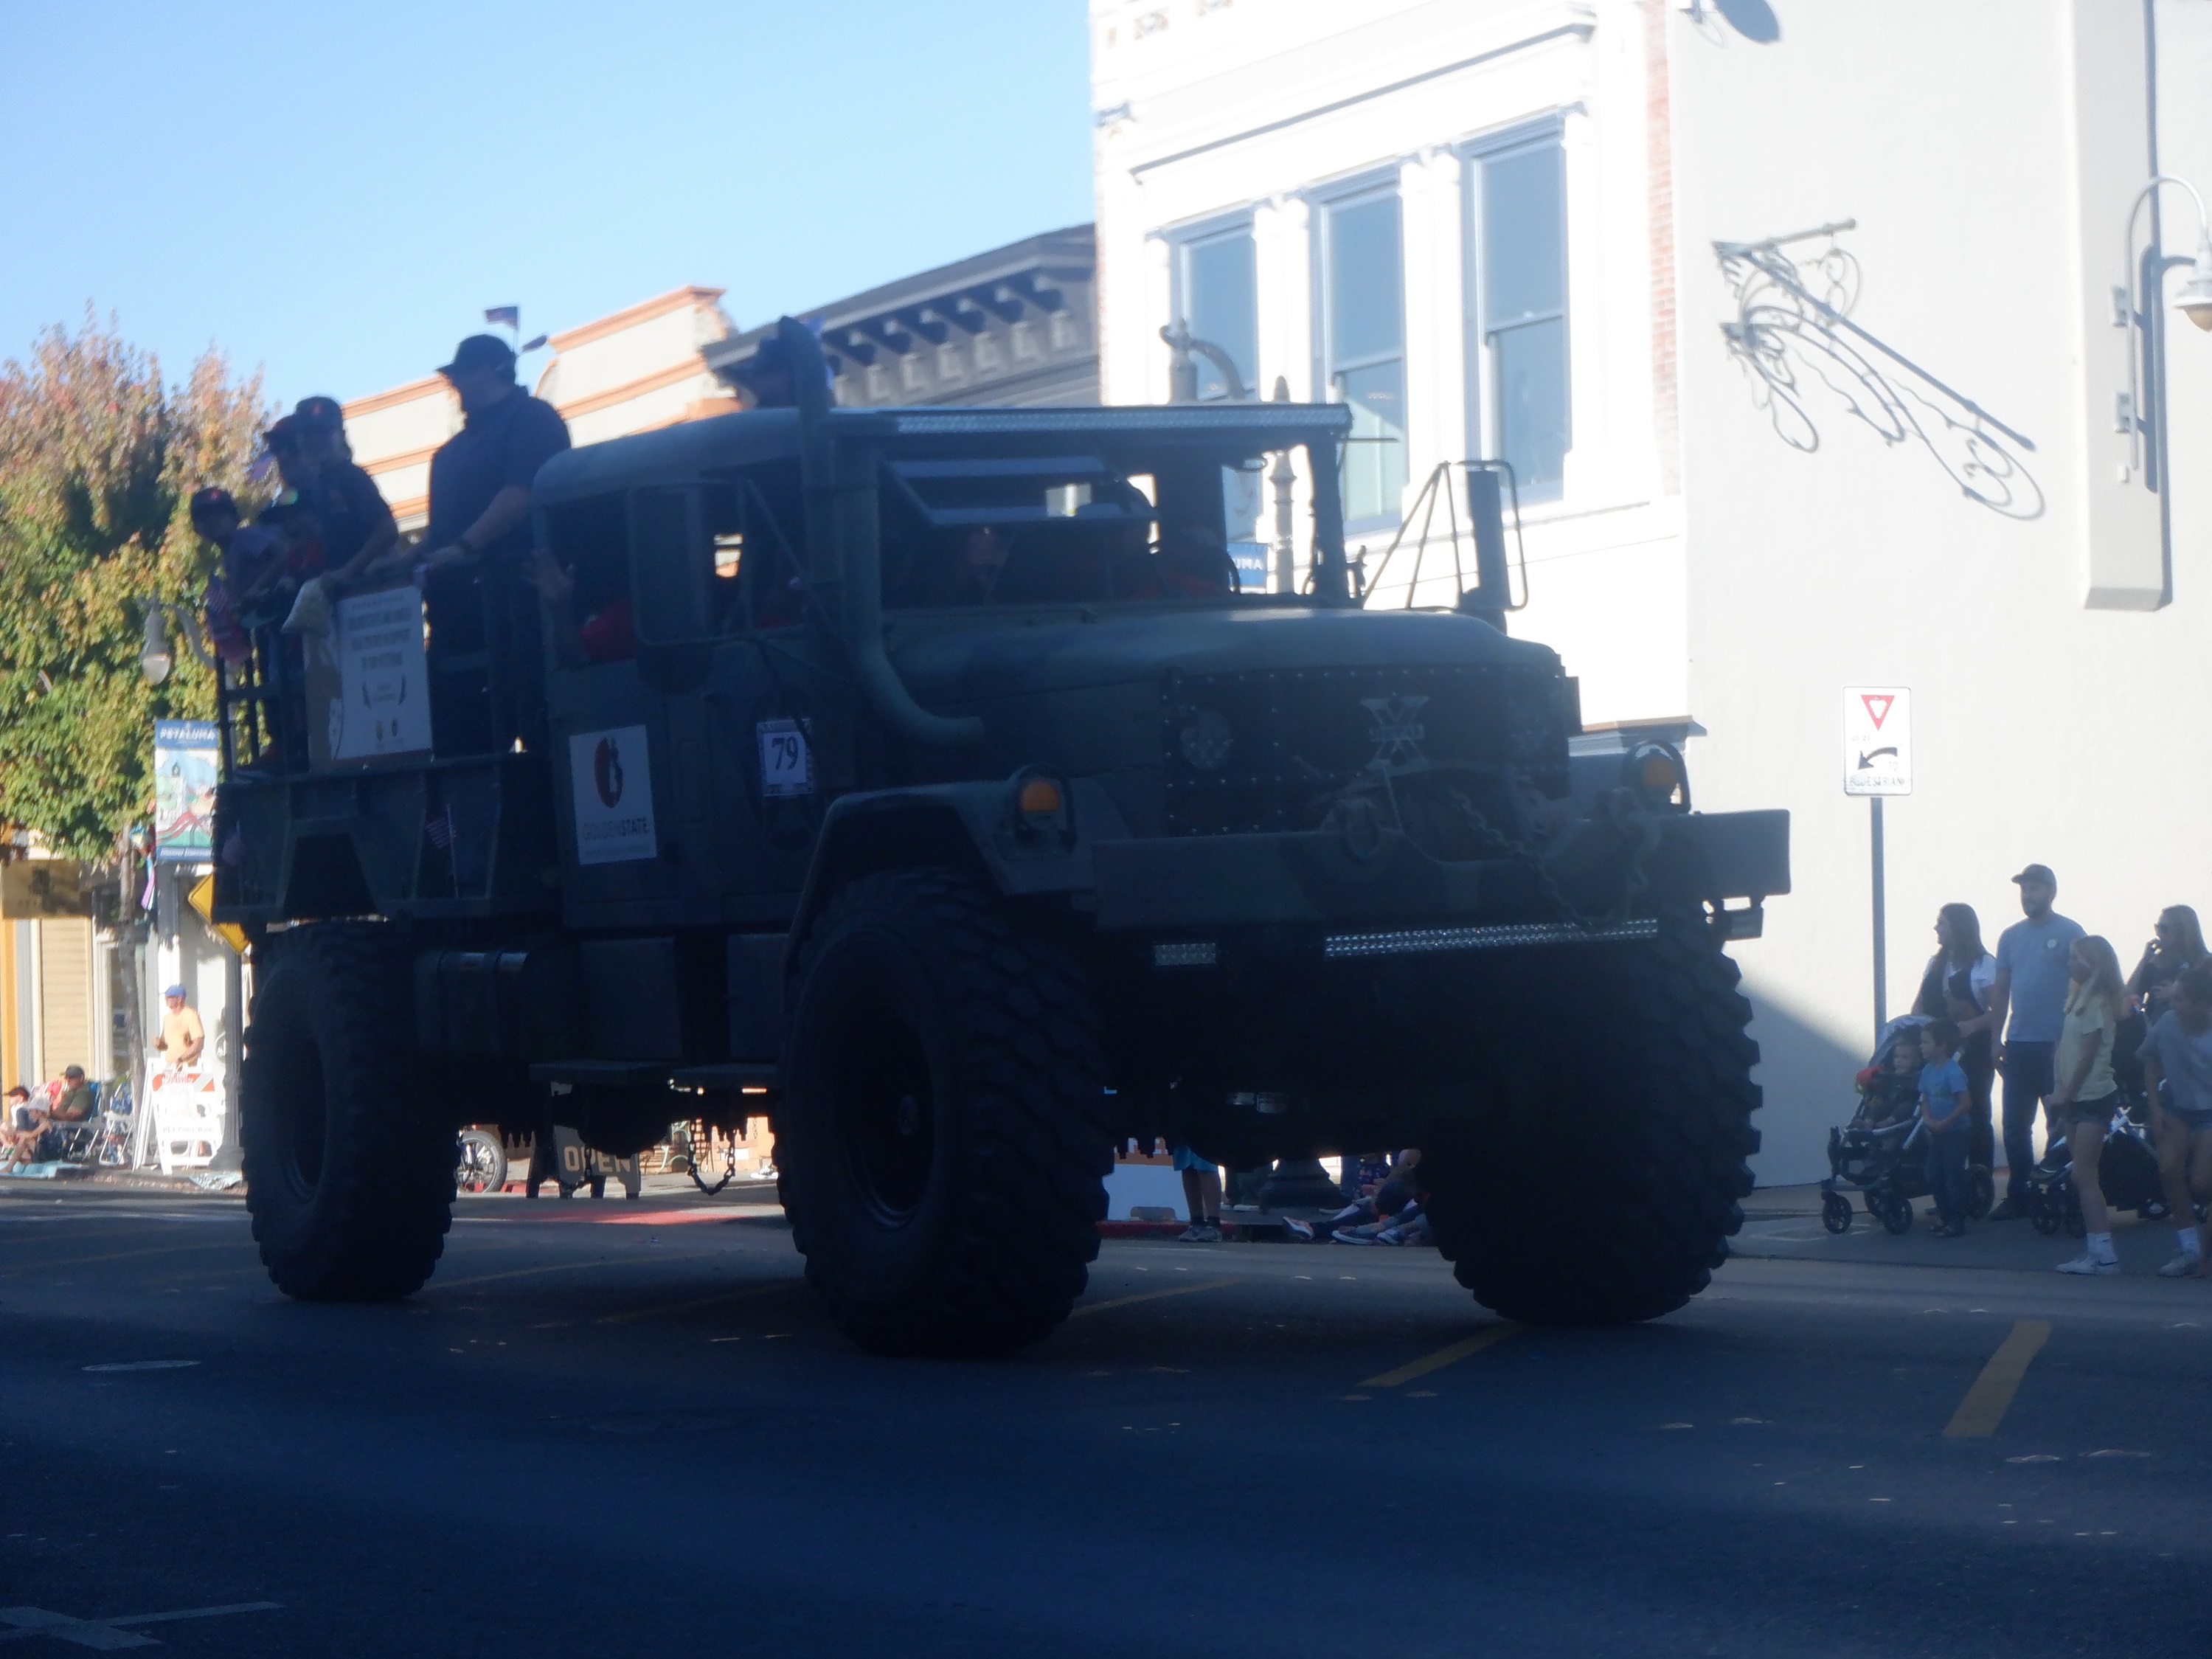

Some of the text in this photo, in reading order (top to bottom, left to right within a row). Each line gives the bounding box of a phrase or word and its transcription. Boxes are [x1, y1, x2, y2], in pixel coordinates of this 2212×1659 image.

[160, 727, 216, 741] PETALUMA
[772, 736, 799, 771] 79
[564, 1146, 631, 1173] OPEN
